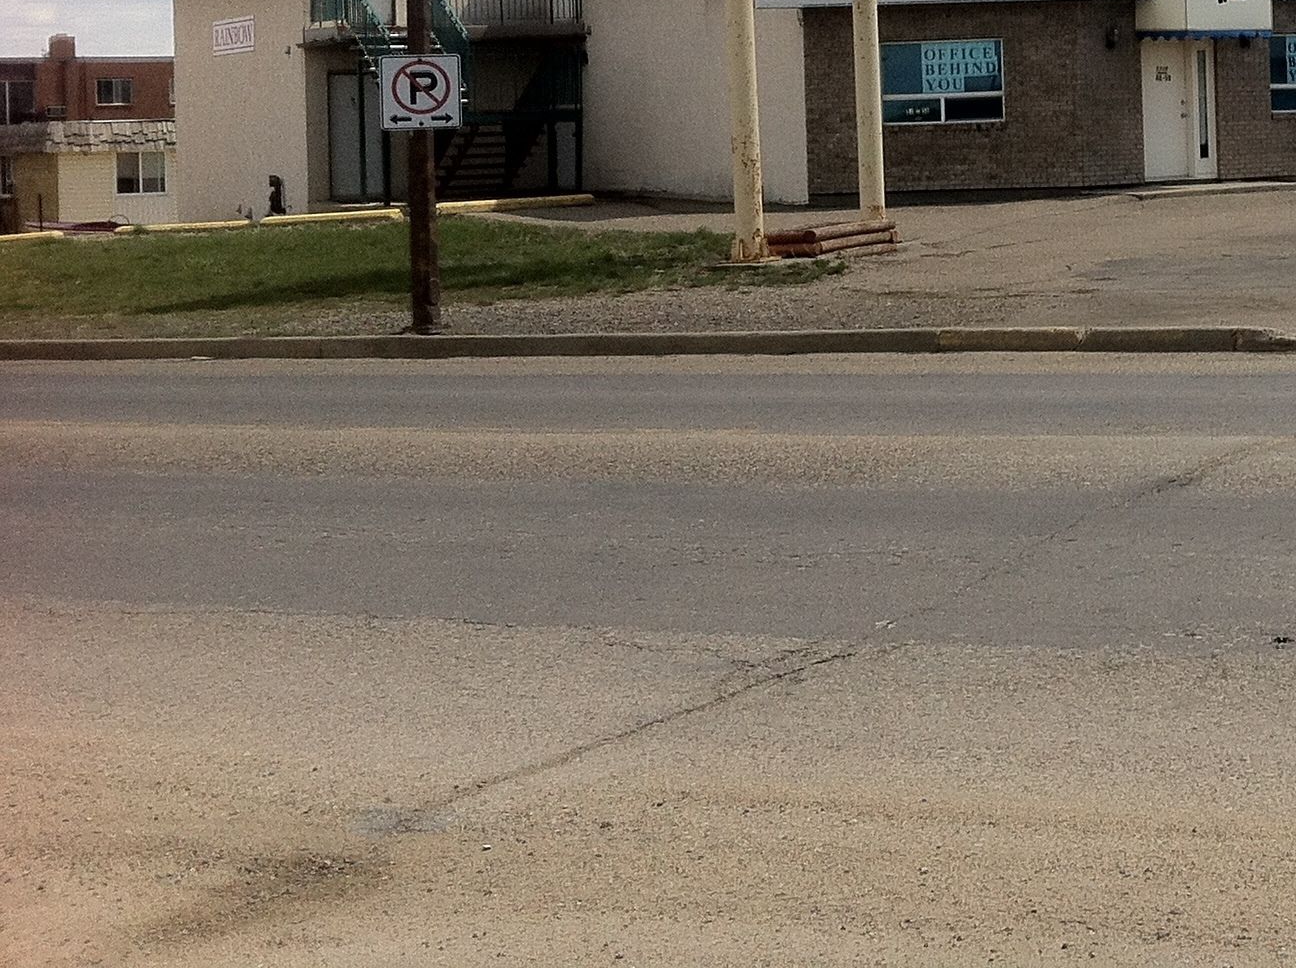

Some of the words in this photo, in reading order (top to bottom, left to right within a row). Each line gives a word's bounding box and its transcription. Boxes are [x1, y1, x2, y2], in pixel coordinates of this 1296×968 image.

[214, 23, 253, 47] RAINBOW
[923, 46, 993, 61] OFFICE
[924, 61, 998, 76] BEHIND
[925, 77, 964, 91] YOU
